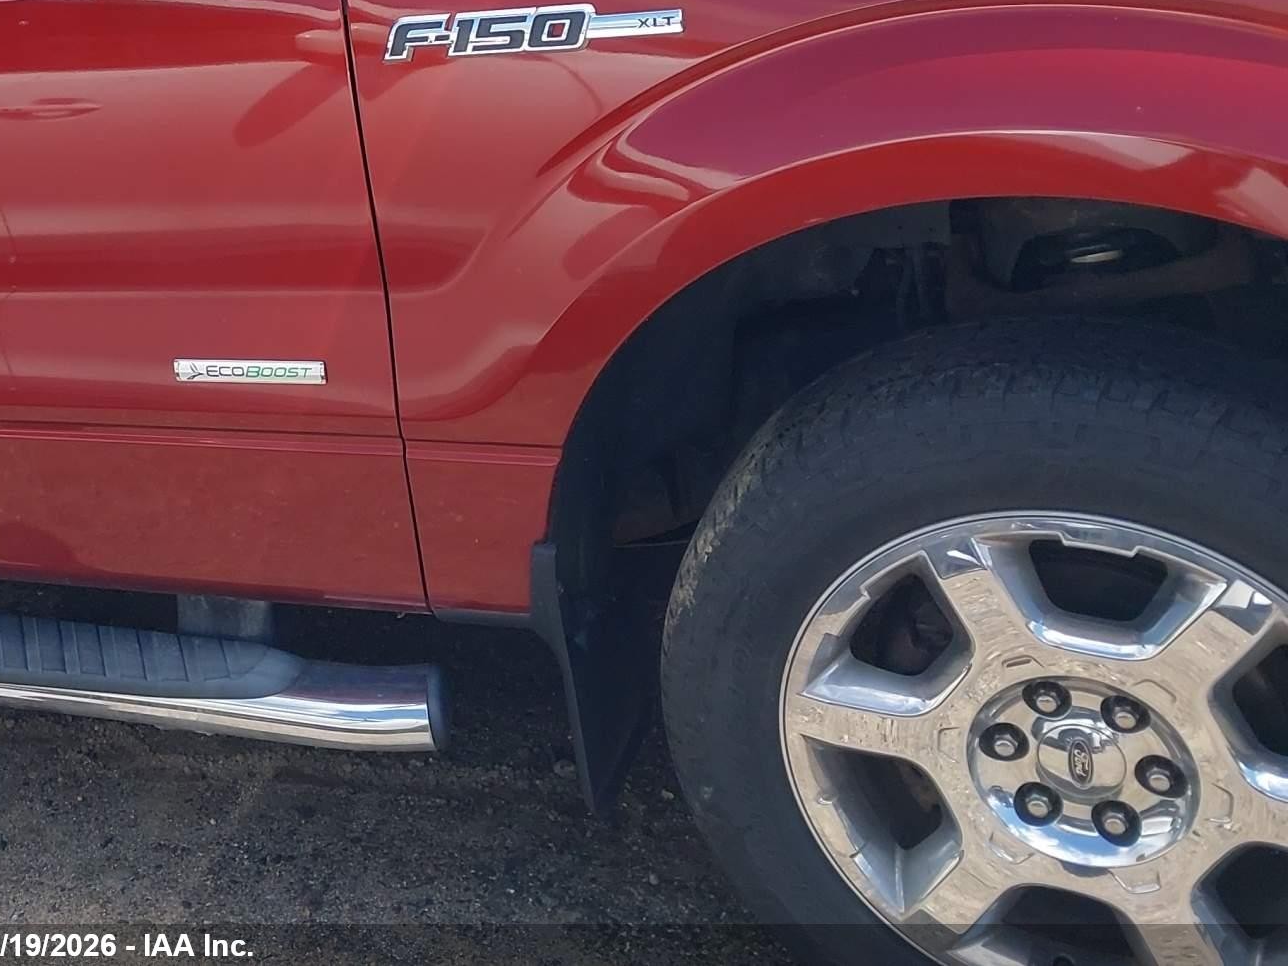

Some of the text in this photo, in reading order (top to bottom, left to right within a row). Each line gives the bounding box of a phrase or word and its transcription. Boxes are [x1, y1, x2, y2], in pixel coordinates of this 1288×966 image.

[383, 3, 676, 63] F-150 XLT
[1073, 749, 1089, 777] Ford
